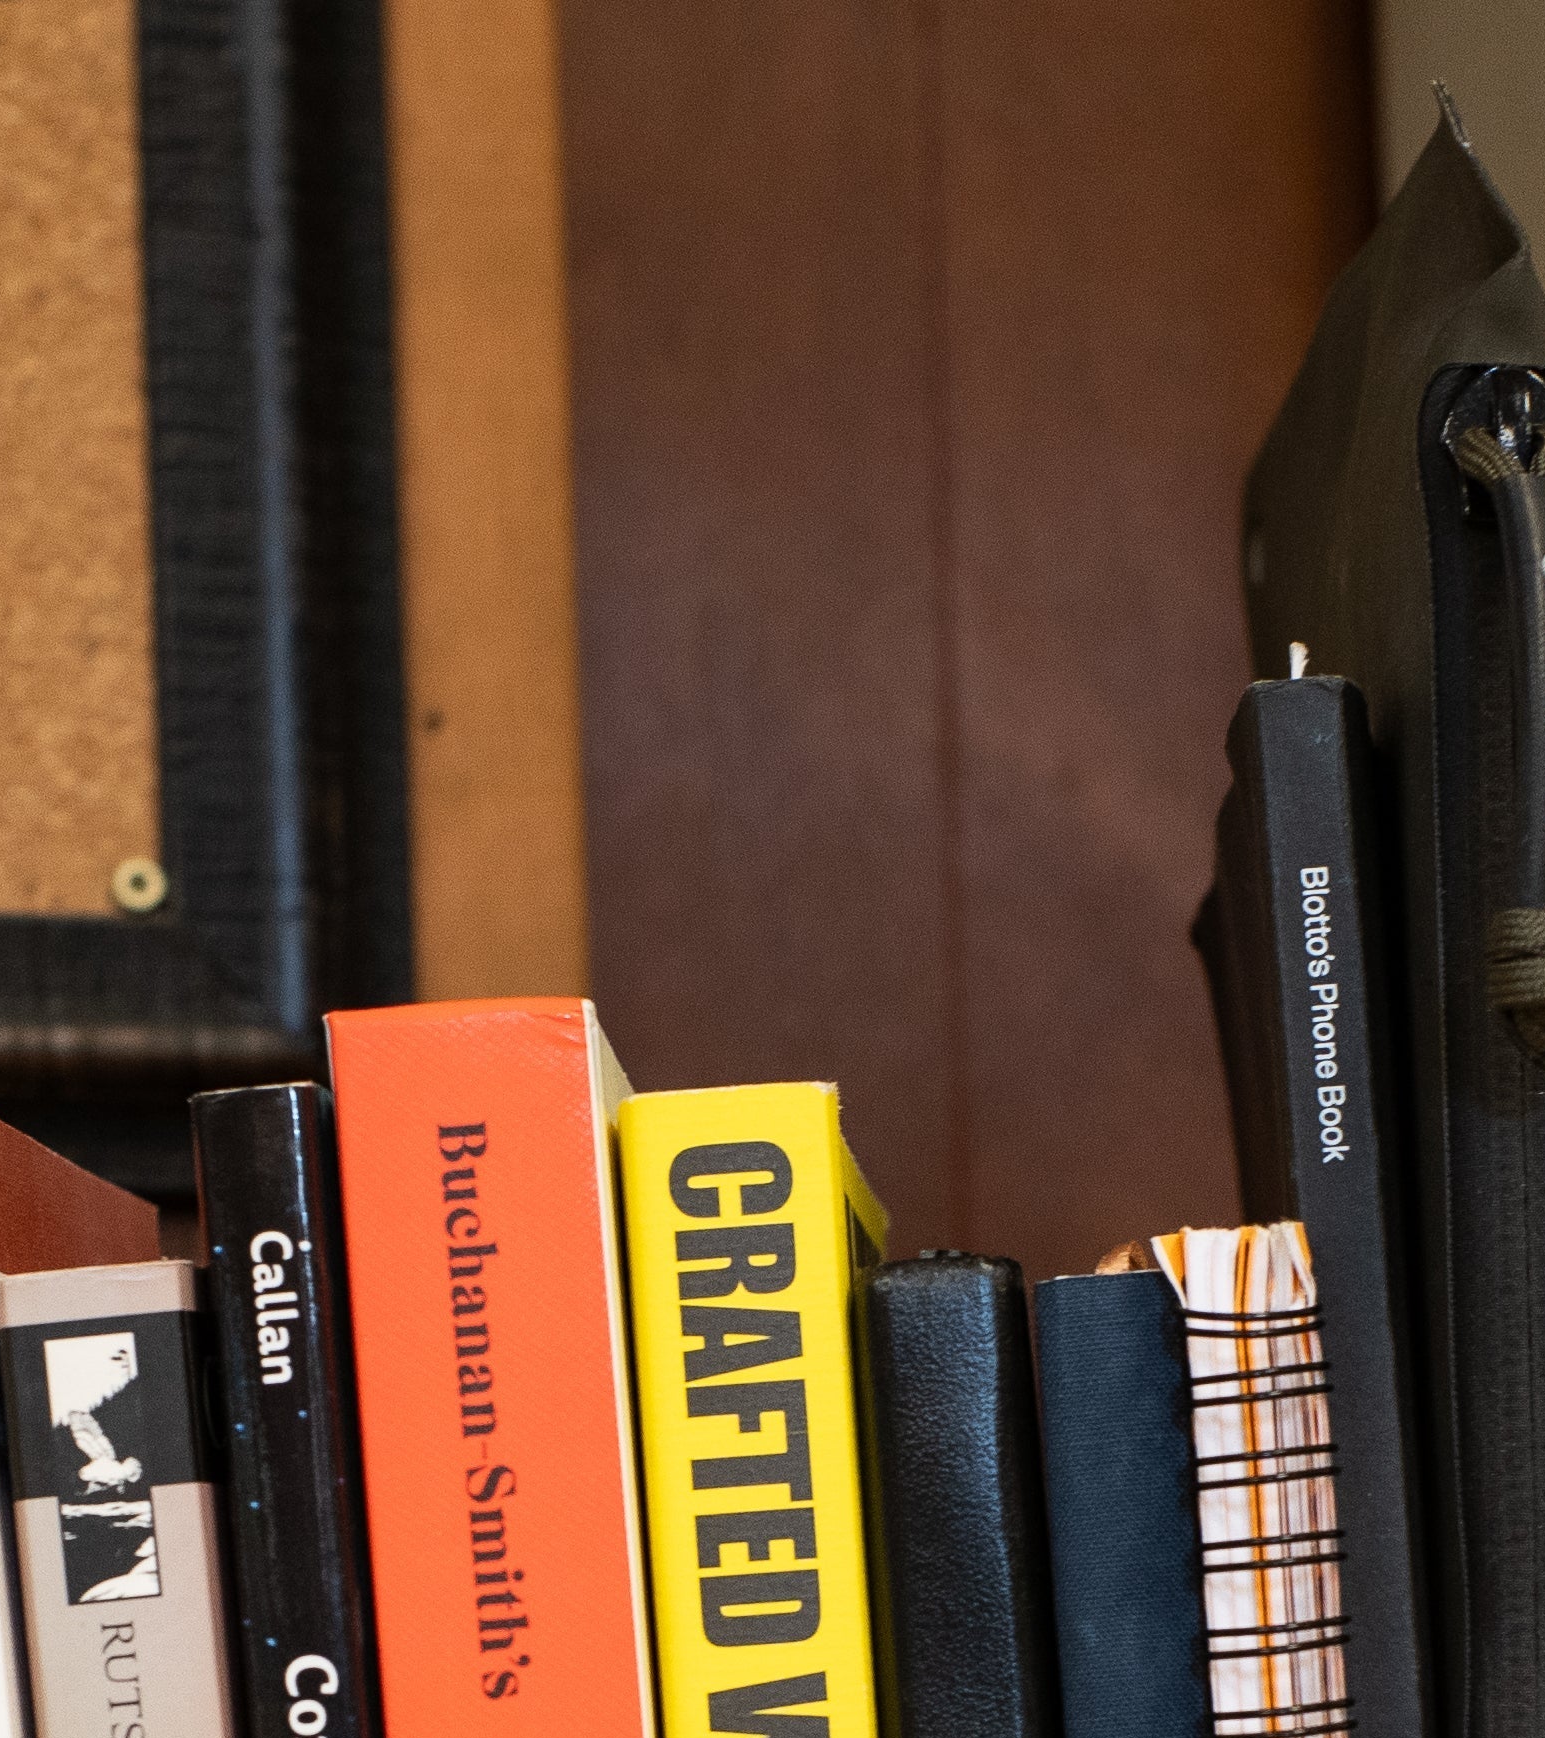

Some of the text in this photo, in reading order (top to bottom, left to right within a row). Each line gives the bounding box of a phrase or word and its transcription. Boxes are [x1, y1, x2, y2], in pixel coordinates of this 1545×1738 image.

[1300, 866, 1350, 1164] Blotto's Phone Book
[250, 1230, 300, 1385] Callan
[437, 1121, 531, 1701] Buchanan-Smith's
[668, 1140, 822, 1648] CRAFTED
